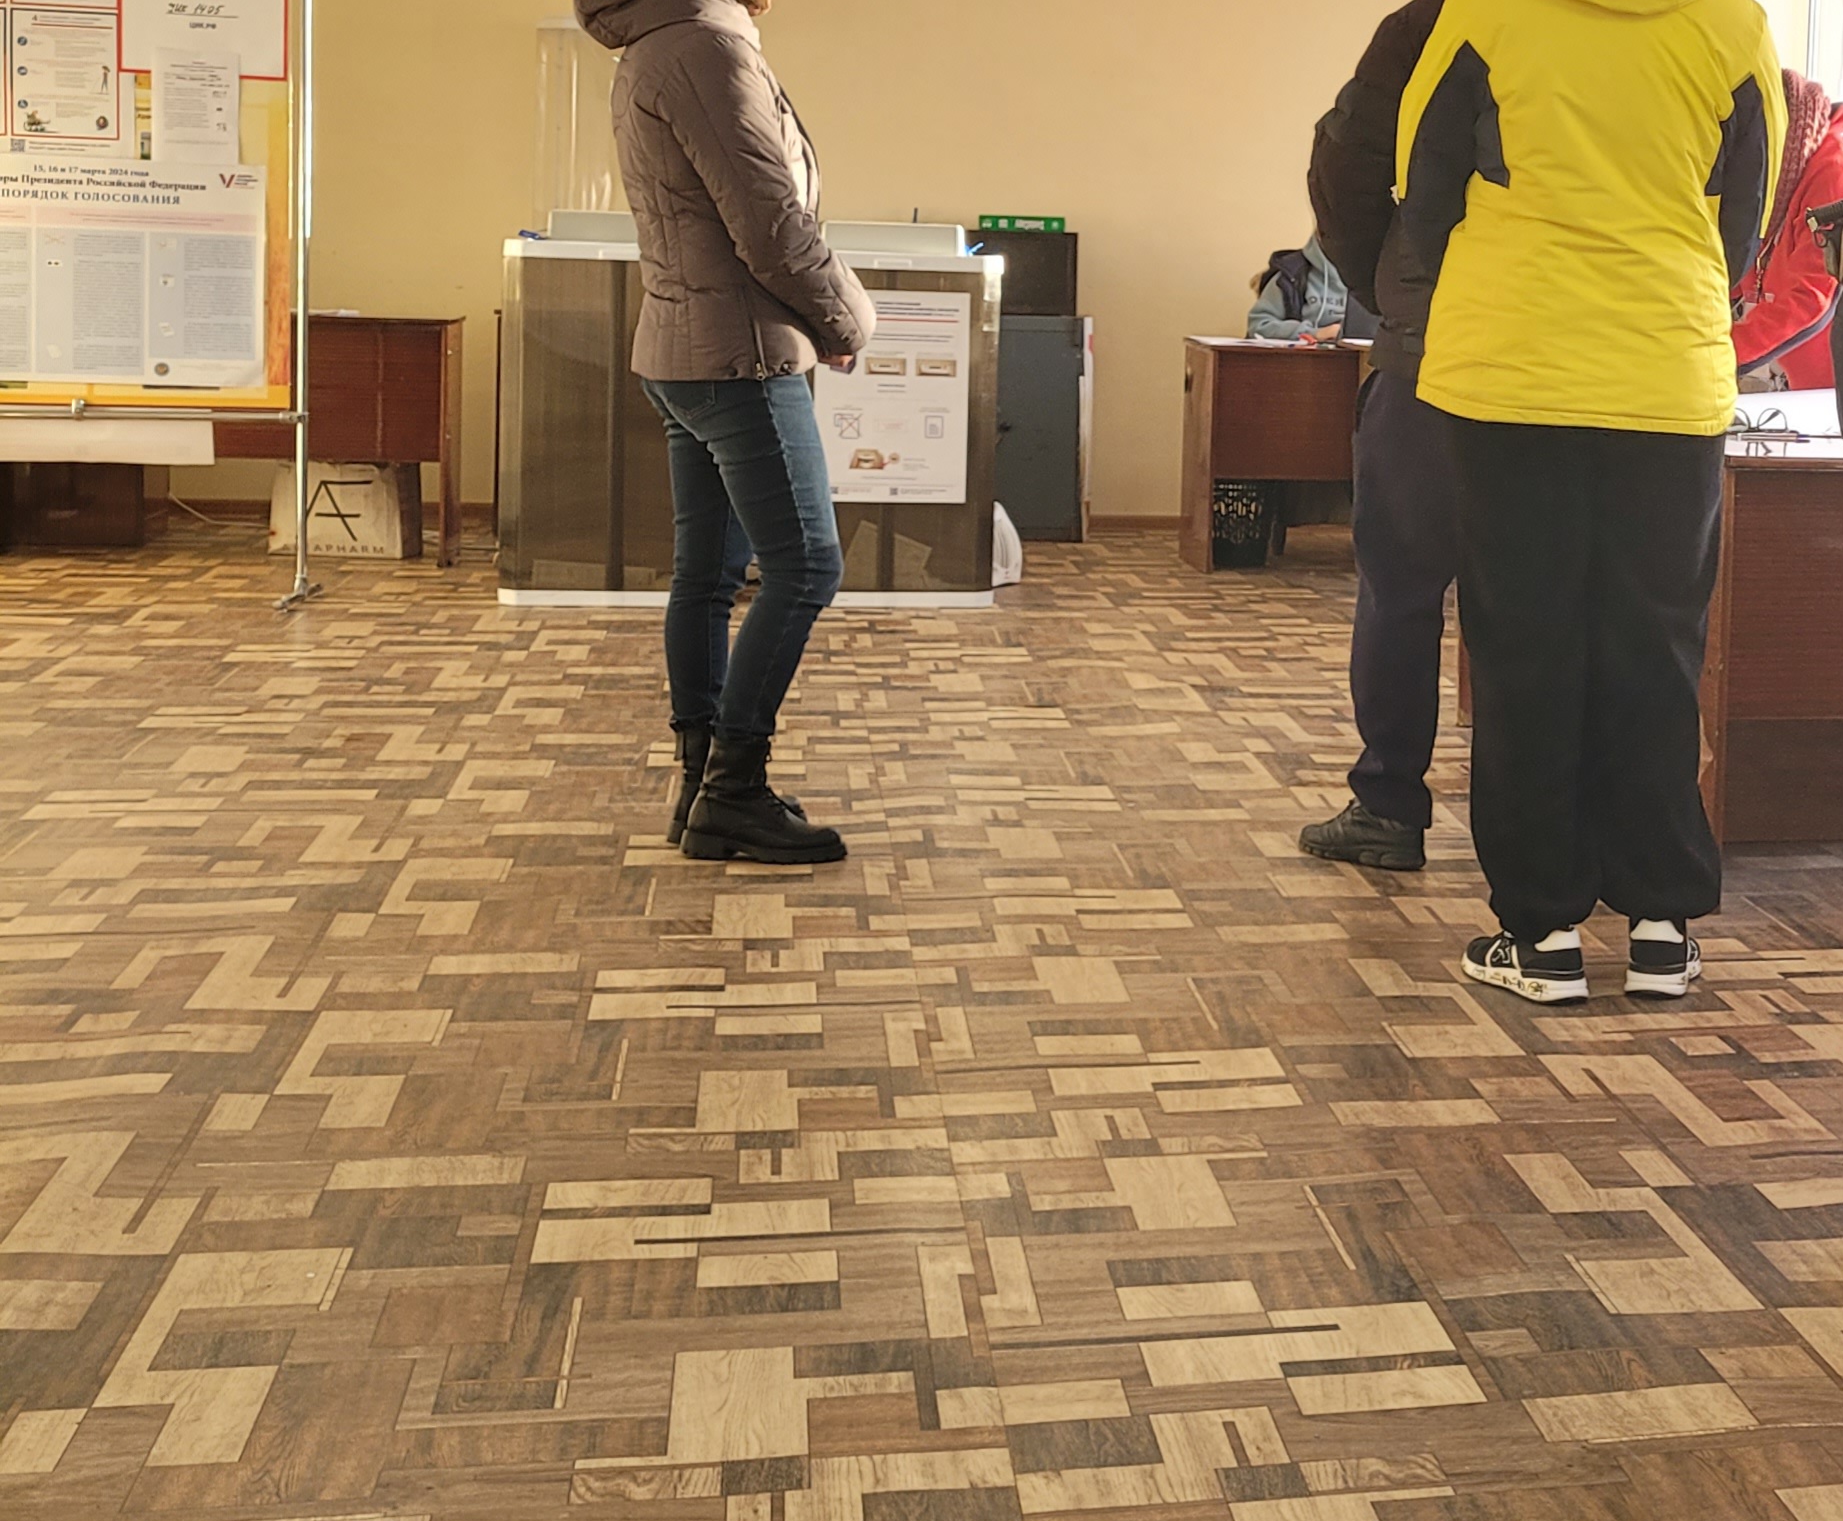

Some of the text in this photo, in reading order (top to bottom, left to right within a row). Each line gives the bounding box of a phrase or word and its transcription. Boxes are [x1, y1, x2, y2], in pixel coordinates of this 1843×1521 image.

[21, 174, 83, 185] Президента
[86, 177, 146, 188] Российской
[149, 180, 207, 192] Федерации
[1, 188, 181, 205] ПОРЯДОК ГОЛОСОВАНИЯ
